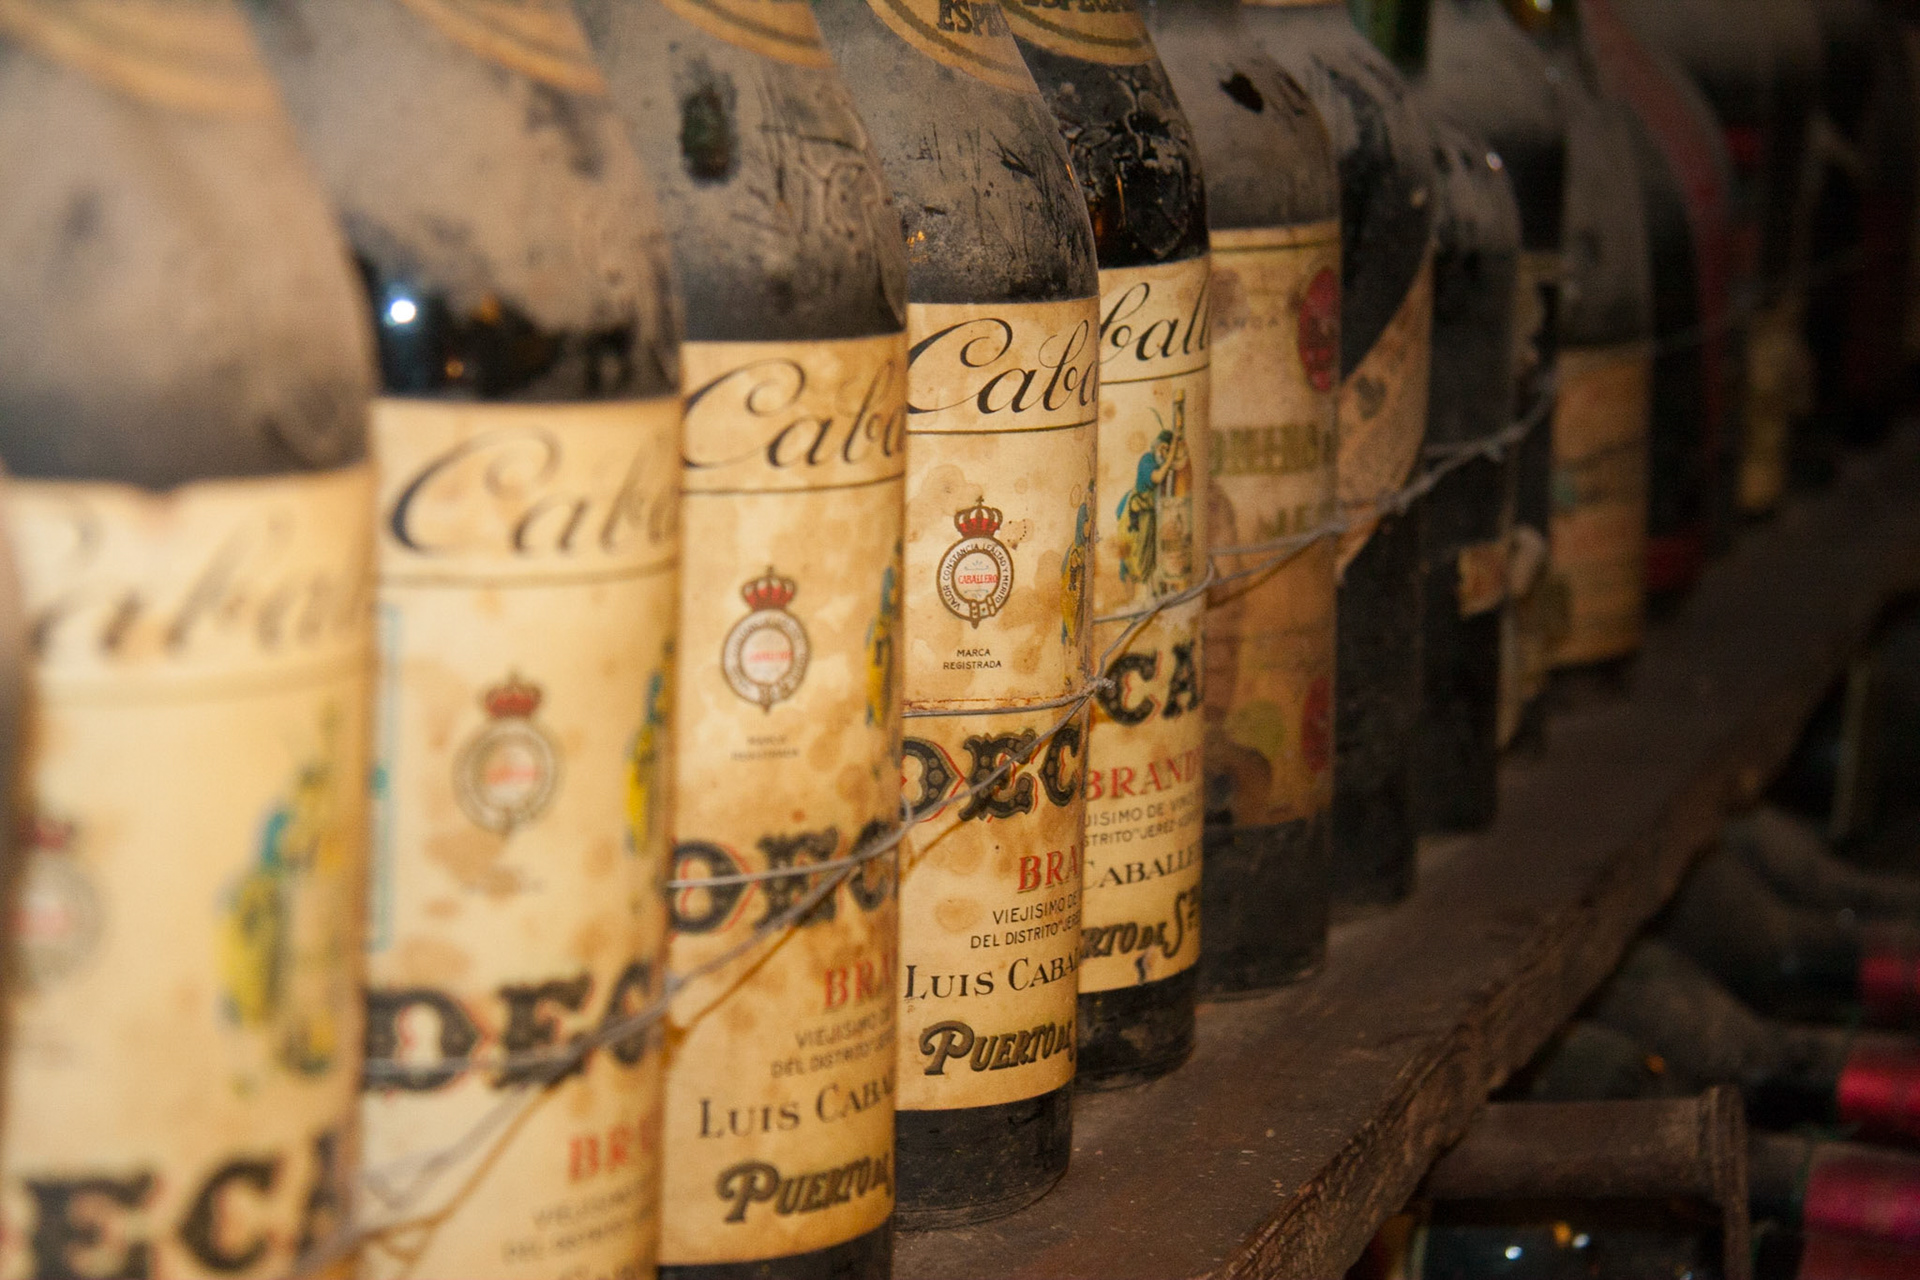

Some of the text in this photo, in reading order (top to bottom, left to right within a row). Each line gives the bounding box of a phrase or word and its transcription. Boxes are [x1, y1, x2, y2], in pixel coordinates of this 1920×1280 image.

[943, 660, 1002, 670] REGISTRADA
[956, 648, 991, 657] MARCA
[902, 724, 1082, 823] DEC
[992, 897, 1066, 925] VIEJISIMO
[970, 933, 1000, 949] DEL
[904, 964, 995, 1000] LUIS
[918, 1020, 1055, 1077] PUERTO
[698, 1097, 800, 1139] LUIS
[716, 1155, 871, 1224] PUERTO
